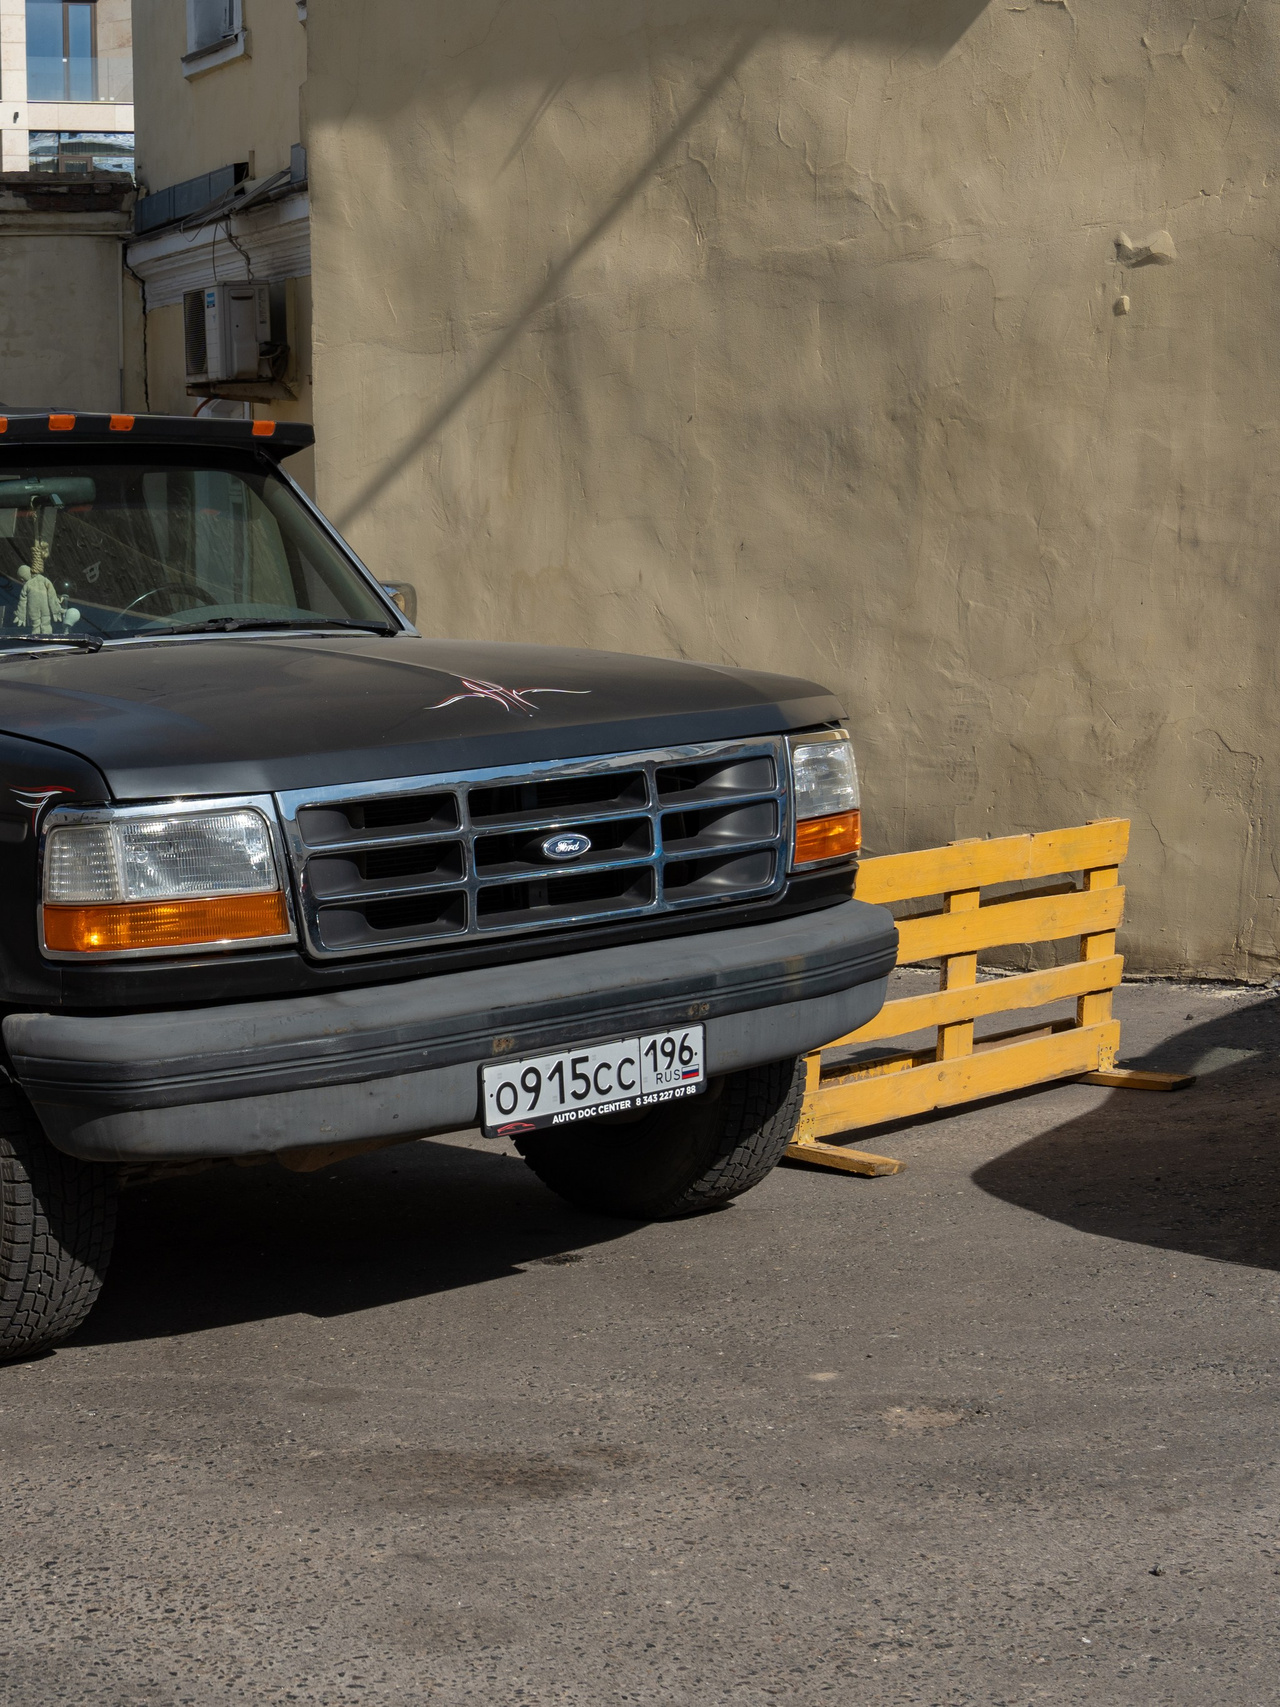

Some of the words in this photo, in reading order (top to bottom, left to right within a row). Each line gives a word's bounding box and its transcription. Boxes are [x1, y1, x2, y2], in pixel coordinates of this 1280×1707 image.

[555, 839, 580, 853] Ford
[643, 1032, 694, 1073] 196
[656, 1069, 681, 1085] RUS
[552, 1111, 577, 1125] AUTO
[578, 1107, 597, 1119] DOC
[598, 1100, 632, 1115] CENTER
[635, 1097, 642, 1106] 8
[642, 1094, 658, 1105] 343
[659, 1090, 673, 1101] 227
[674, 1087, 685, 1097] 07
[686, 1085, 696, 1094] 88
